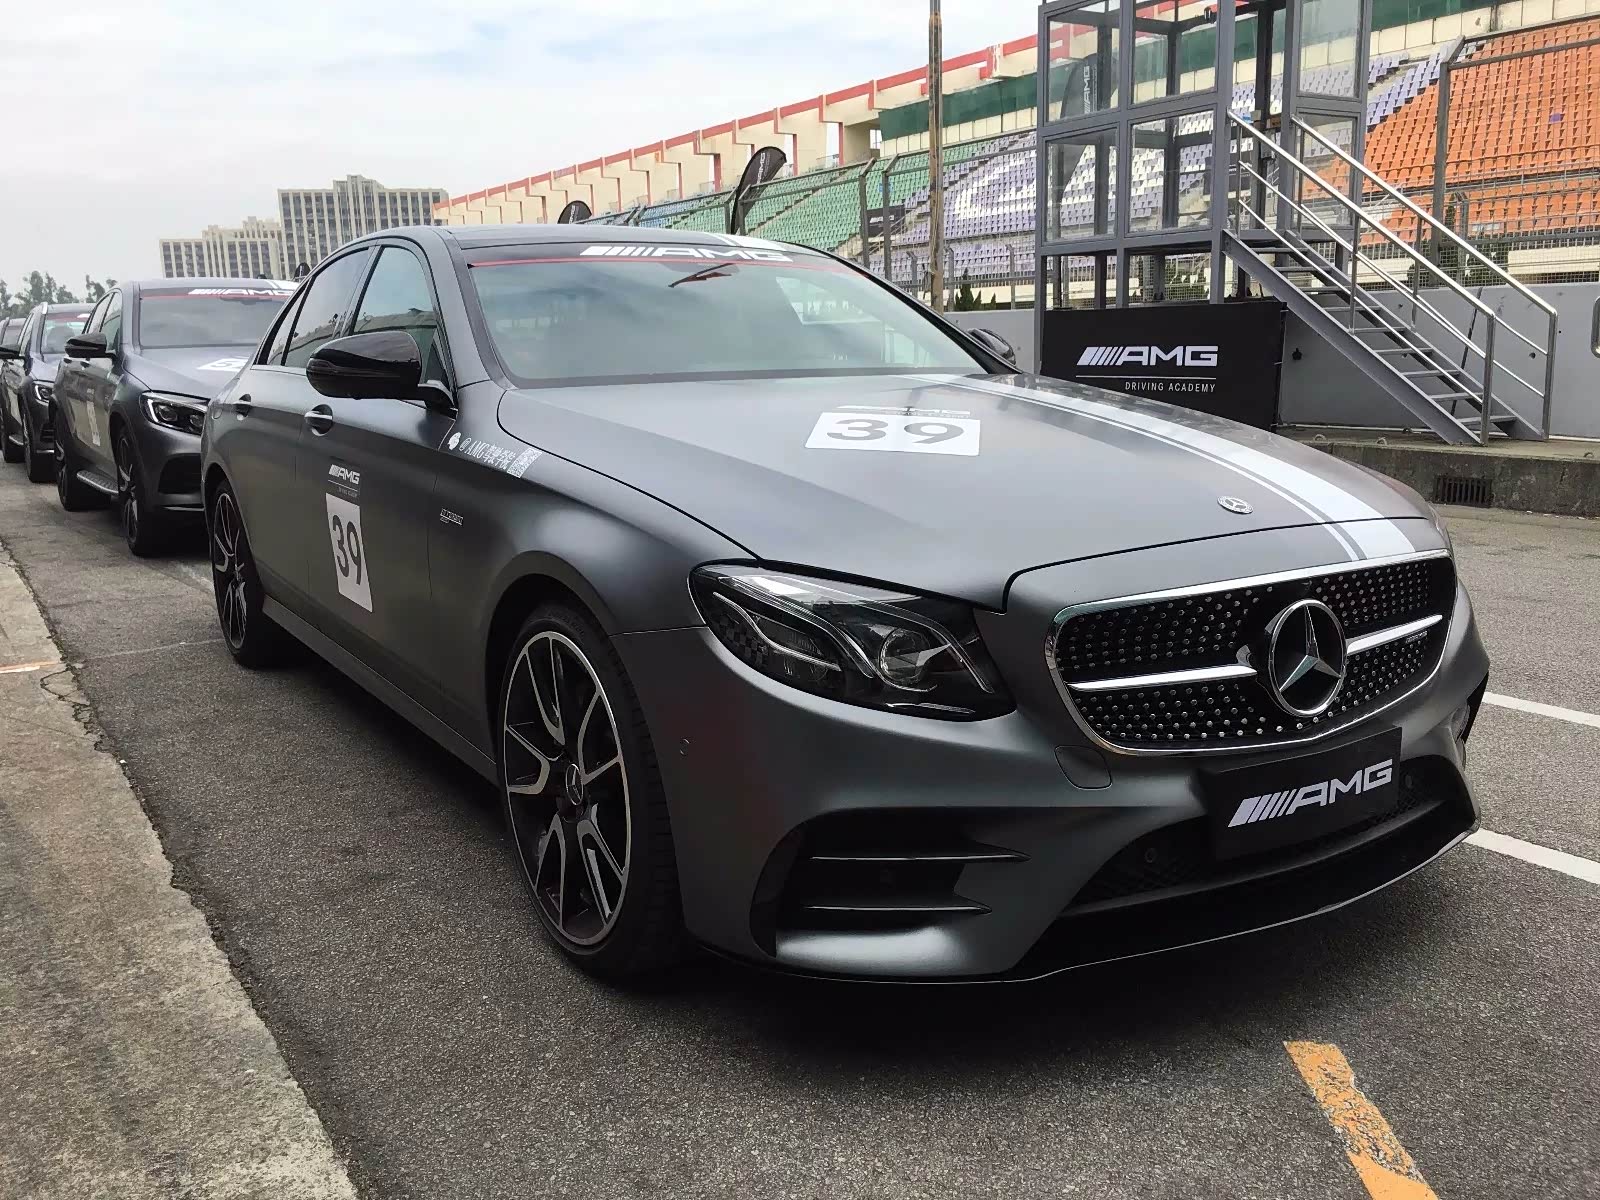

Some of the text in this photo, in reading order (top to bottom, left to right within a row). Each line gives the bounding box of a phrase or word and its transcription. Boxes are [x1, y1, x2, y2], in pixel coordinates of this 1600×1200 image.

[652, 247, 793, 262] AMG
[1115, 345, 1219, 367] AMG
[1125, 381, 1216, 393] DRIVING ACADEMY
[826, 418, 965, 444] 39
[337, 466, 360, 485] AMG
[332, 514, 362, 586] 39
[1286, 758, 1393, 816] AMG
